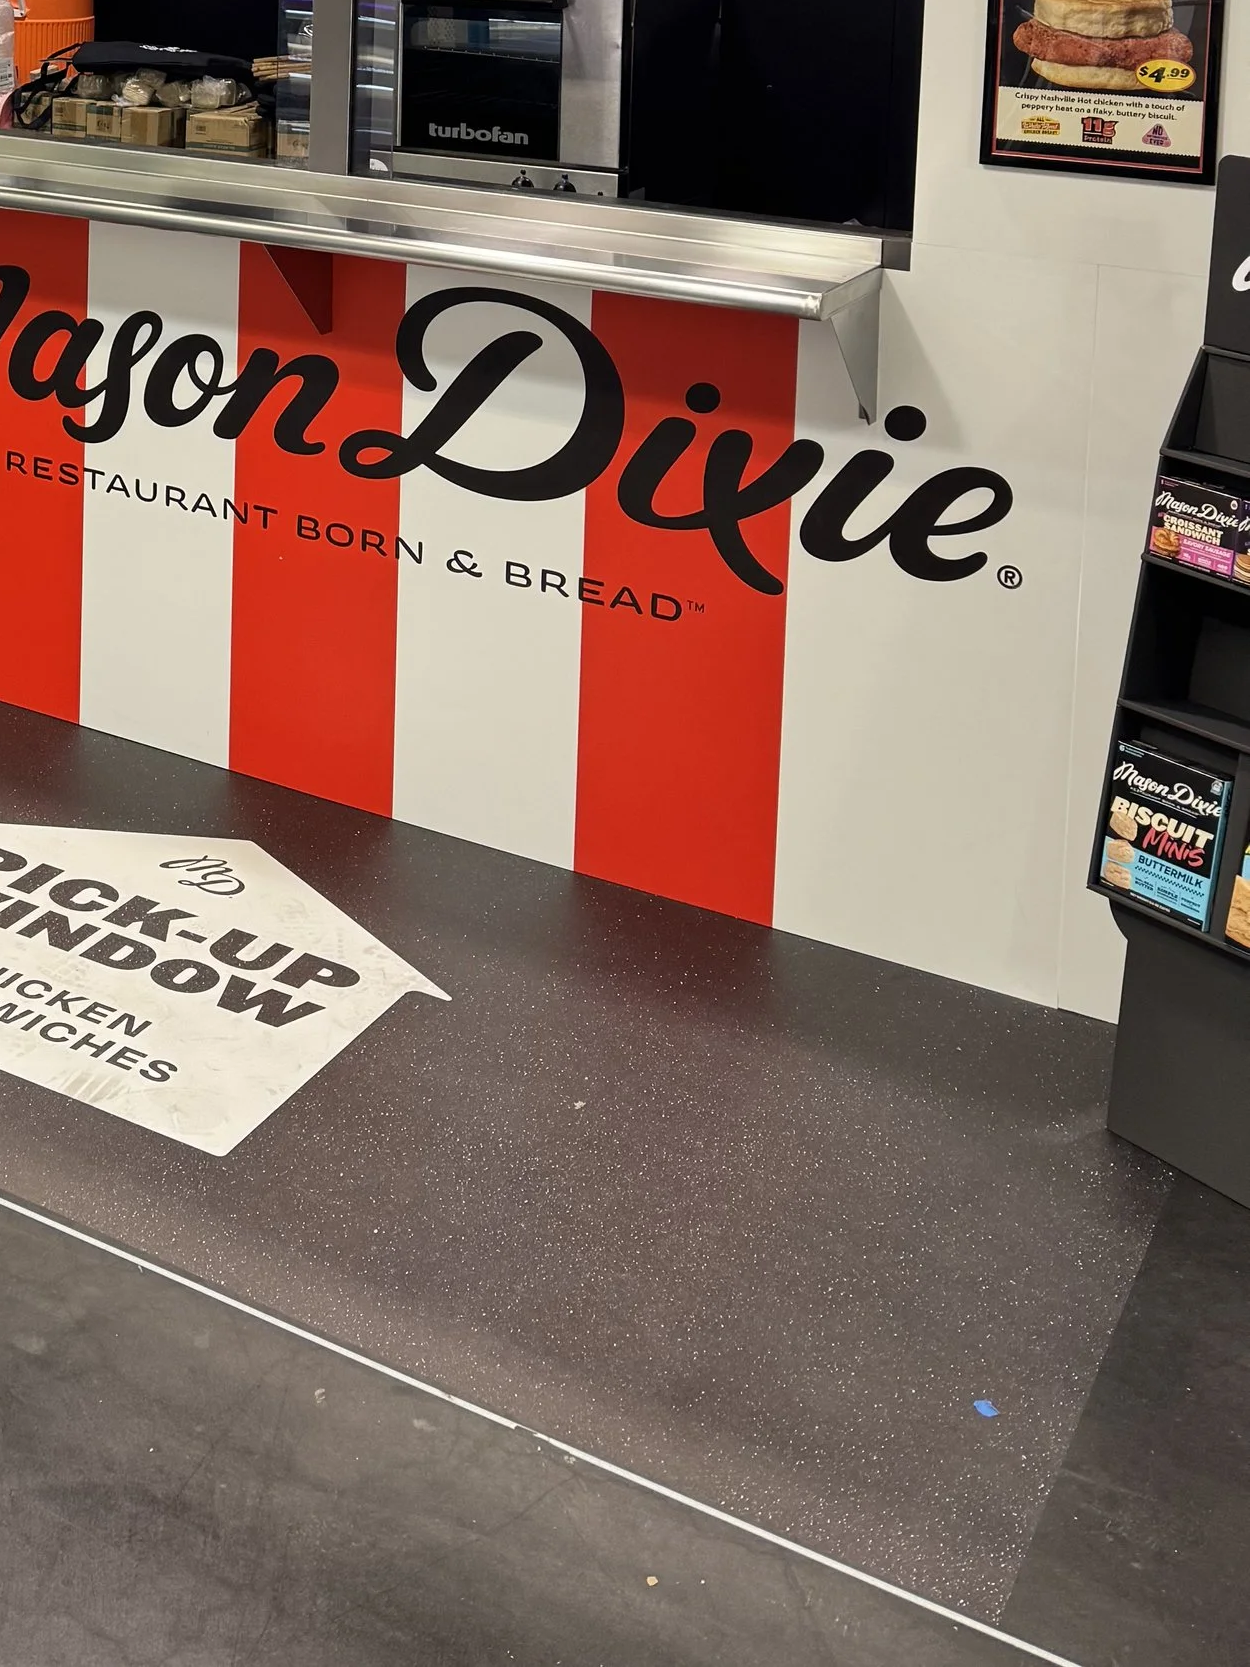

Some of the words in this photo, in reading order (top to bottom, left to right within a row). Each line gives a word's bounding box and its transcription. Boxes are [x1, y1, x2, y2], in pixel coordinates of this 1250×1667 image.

[1139, 65, 1190, 83] $4.99
[1015, 92, 1039, 101] Crispy
[1041, 94, 1076, 103] Nashville
[1093, 97, 1124, 107] chicken
[1126, 101, 1143, 109] with
[1151, 103, 1174, 111] touch
[1021, 103, 1054, 112] peppery
[1117, 109, 1146, 119] buttery
[1148, 112, 1178, 121] biscuit.
[429, 122, 529, 145] turbofan
[1083, 117, 1117, 138] 11g
[1152, 125, 1164, 136] NO
[1083, 135, 1112, 144] Protein
[6, 450, 278, 531] RESTAURANT
[297, 516, 423, 565] BORN
[446, 549, 483, 579] &
[1155, 491, 1199, 514] Mason
[1197, 503, 1240, 528] Dixie
[1163, 514, 1224, 538] CROISSANT
[1163, 522, 1221, 546] SANDWICH
[1183, 538, 1204, 550] SAVORY
[1205, 545, 1231, 558] SAUSAGE
[1113, 761, 1171, 796] Mason
[1168, 782, 1222, 817] Dixie
[1110, 796, 1214, 852] BISCUIT
[1138, 855, 1204, 889] BUTTERMILK
